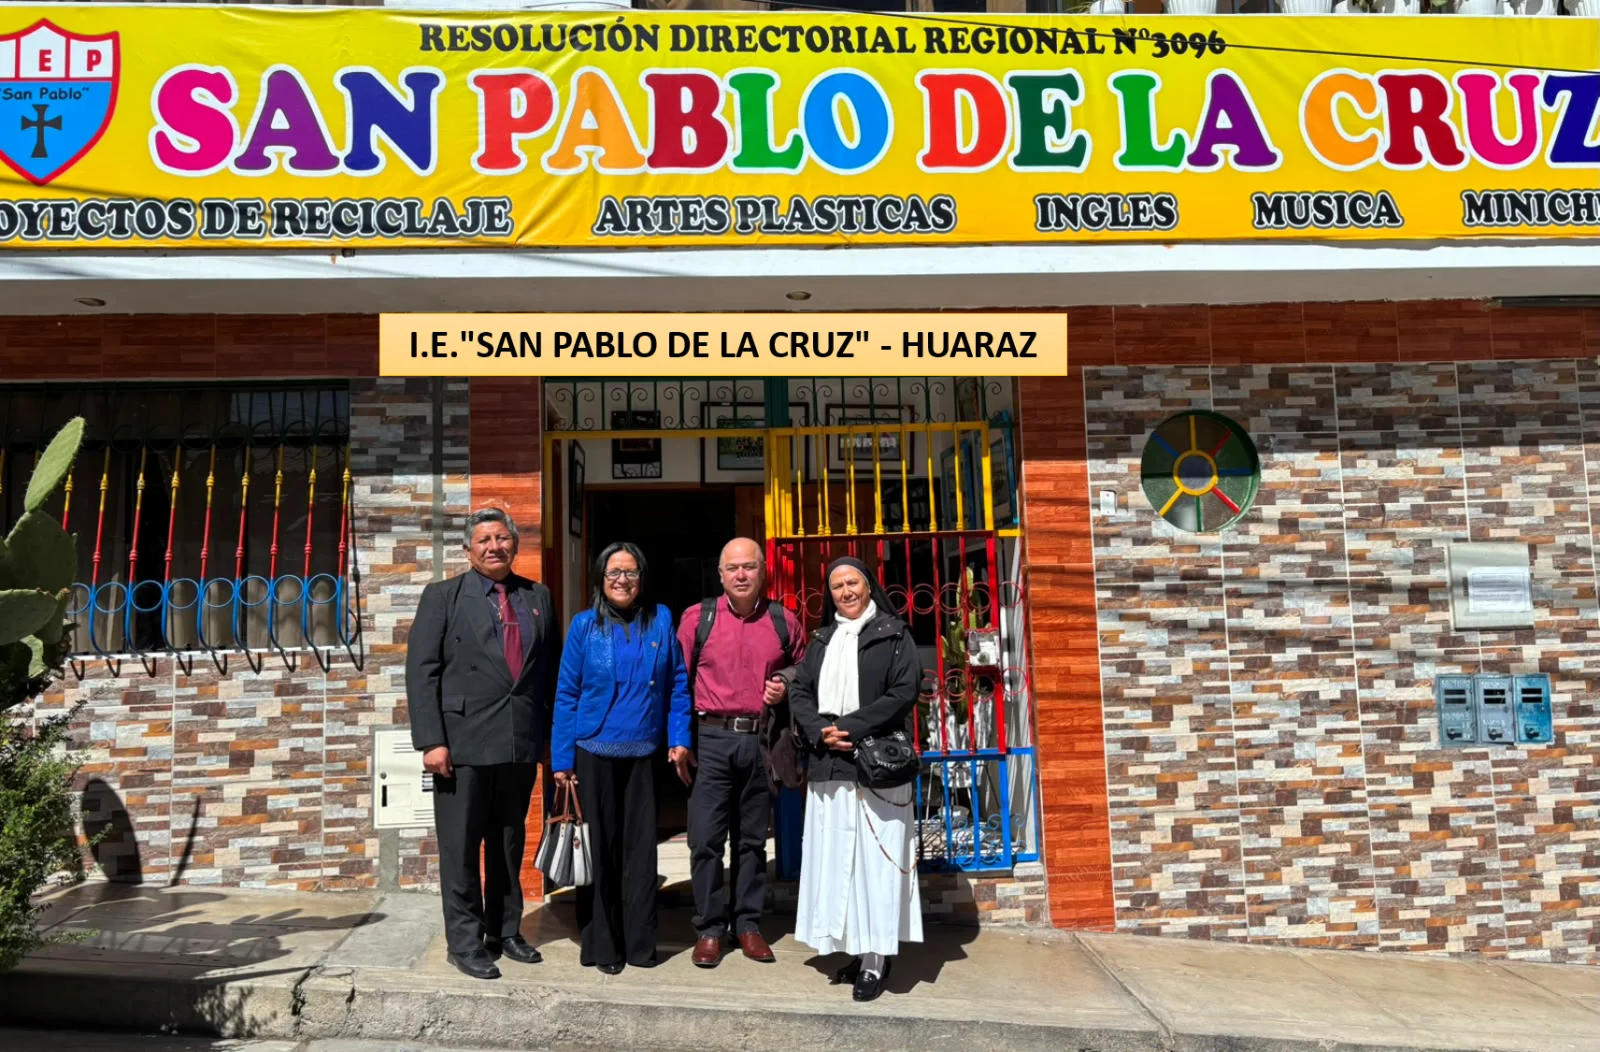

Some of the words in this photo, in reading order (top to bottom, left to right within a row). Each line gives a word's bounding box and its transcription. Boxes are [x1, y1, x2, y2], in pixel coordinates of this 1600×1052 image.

[420, 17, 660, 52] RESOLUCIÓN
[670, 24, 917, 53] DIRECTORIAL
[924, 26, 1106, 54] REGIONAL
[38, 49, 52, 72] E
[86, 49, 102, 72] P
[149, 63, 445, 176] SAN
[468, 66, 893, 175] PABLO
[916, 68, 1091, 173] DE
[1108, 68, 1282, 172] LA
[1299, 68, 1600, 171] CRUZ
[201, 199, 267, 238] DE
[267, 198, 512, 237] RECICLAJE
[594, 196, 730, 235] ARTES
[732, 195, 957, 234] PLASTICAS
[1034, 193, 1179, 231] INGLES
[1251, 191, 1404, 229] MUSICA
[1461, 190, 1600, 226] MINICH
